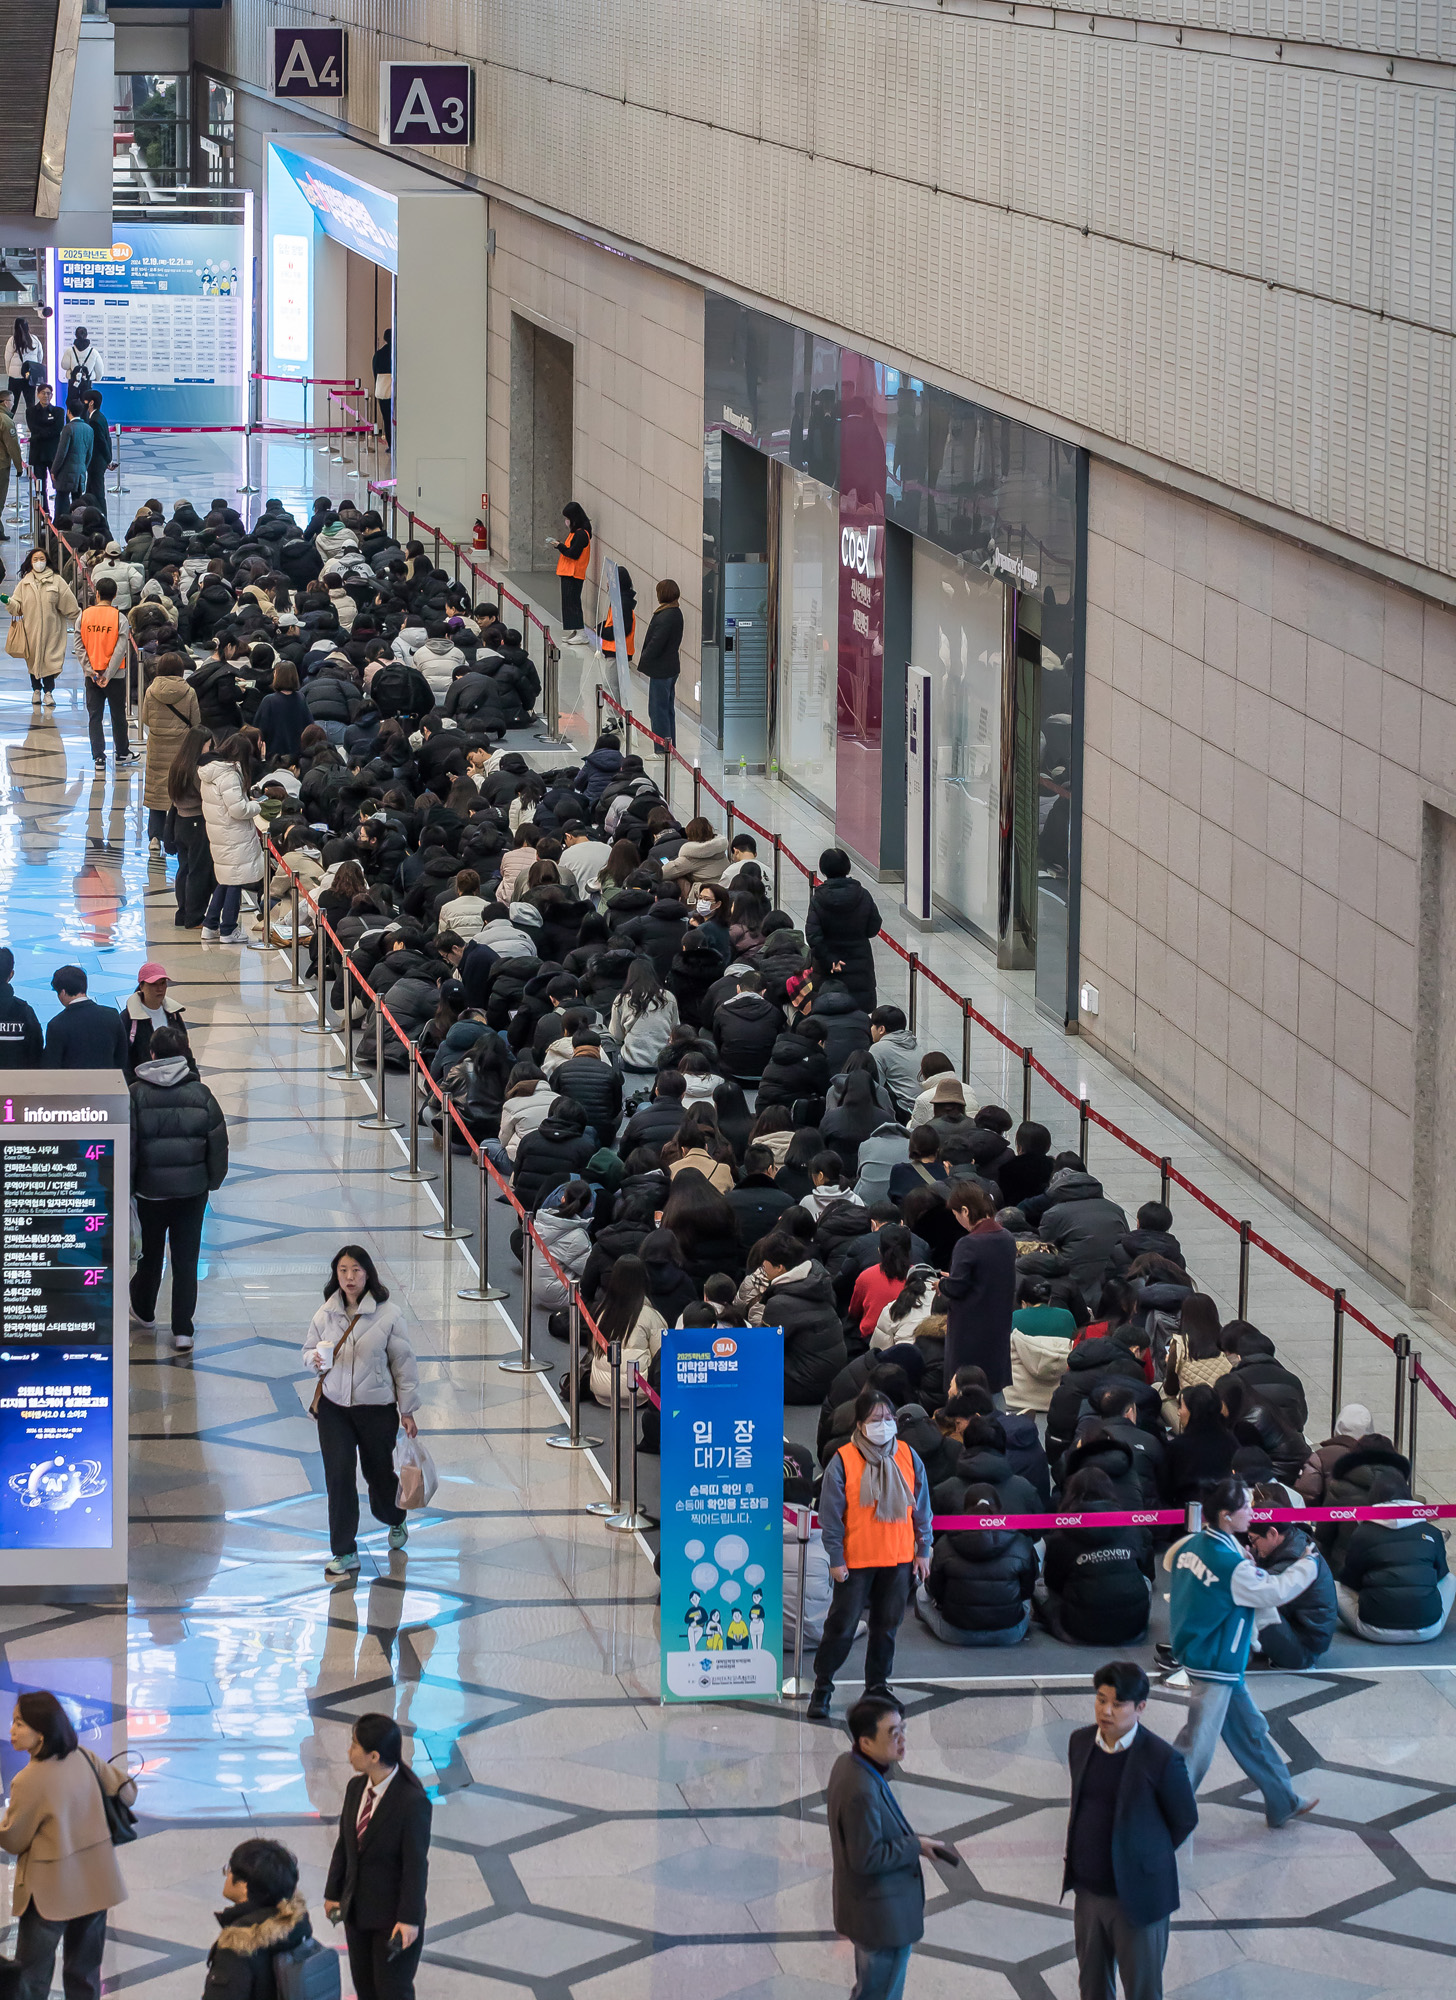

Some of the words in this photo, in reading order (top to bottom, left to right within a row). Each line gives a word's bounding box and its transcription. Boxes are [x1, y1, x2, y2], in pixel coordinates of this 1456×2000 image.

[278, 39, 340, 87] A4
[394, 77, 464, 134] A3
[63, 250, 108, 260] 2025학년도
[112, 247, 129, 257] 정시
[63, 264, 126, 276] 대학입학정보
[63, 277, 95, 289] 박람회
[841, 526, 880, 578] coex
[87, 625, 112, 634] STAFF
[24, 1107, 108, 1122] information
[4, 1146, 36, 1154] (주)코엑스
[38, 1146, 59, 1155] 사무실
[85, 1145, 106, 1160] 4F
[4, 1164, 50, 1173] 컨퍼런스룸(남)
[4, 1181, 46, 1190] 무역아카데미
[52, 1181, 78, 1190] ICT센터
[4, 1199, 46, 1208] 한국무역협회
[47, 1198, 96, 1208] 일자리지원센터
[4, 1217, 25, 1225] 전시홀
[26, 1217, 33, 1225] C
[84, 1216, 106, 1232] 3F
[4, 1234, 50, 1243] 컨퍼런스룸(남)
[4, 1252, 38, 1261] 컨퍼런스룸
[39, 1252, 46, 1261] E
[4, 1270, 32, 1279] 더플라츠
[84, 1270, 105, 1286] 2F
[3, 1288, 42, 1296] 스튜디오159
[3, 1305, 32, 1314] 바이킹스
[33, 1305, 48, 1313] 워프
[4, 1322, 46, 1332] 한국무역협회
[46, 1322, 96, 1332] 스타트업브랜치
[716, 1343, 734, 1353] 정시
[676, 1360, 739, 1372] 대학입학정보
[676, 1372, 708, 1384] 박람회
[73, 1385, 92, 1396] 위한
[0, 1397, 28, 1408] 디지털
[28, 1397, 64, 1408] 헬스케어
[65, 1397, 109, 1407] 성과보고회
[66, 1410, 88, 1419] 소아과
[692, 1421, 712, 1444] 입
[734, 1420, 755, 1443] 장
[694, 1446, 753, 1469] 대기줄
[45, 1478, 63, 1492] AI
[689, 1484, 719, 1496] 손목띠
[722, 1483, 742, 1495] 확인
[745, 1483, 754, 1494] 후
[675, 1500, 705, 1511] 손등에
[707, 1498, 737, 1510] 확인용
[740, 1497, 769, 1509] 도장을
[1329, 1508, 1357, 1519] coex
[1412, 1506, 1439, 1517] coex
[690, 1512, 752, 1525] 찍어드립니다.
[979, 1515, 1007, 1527] coex
[1055, 1515, 1083, 1526] coex
[1131, 1512, 1159, 1523] coex
